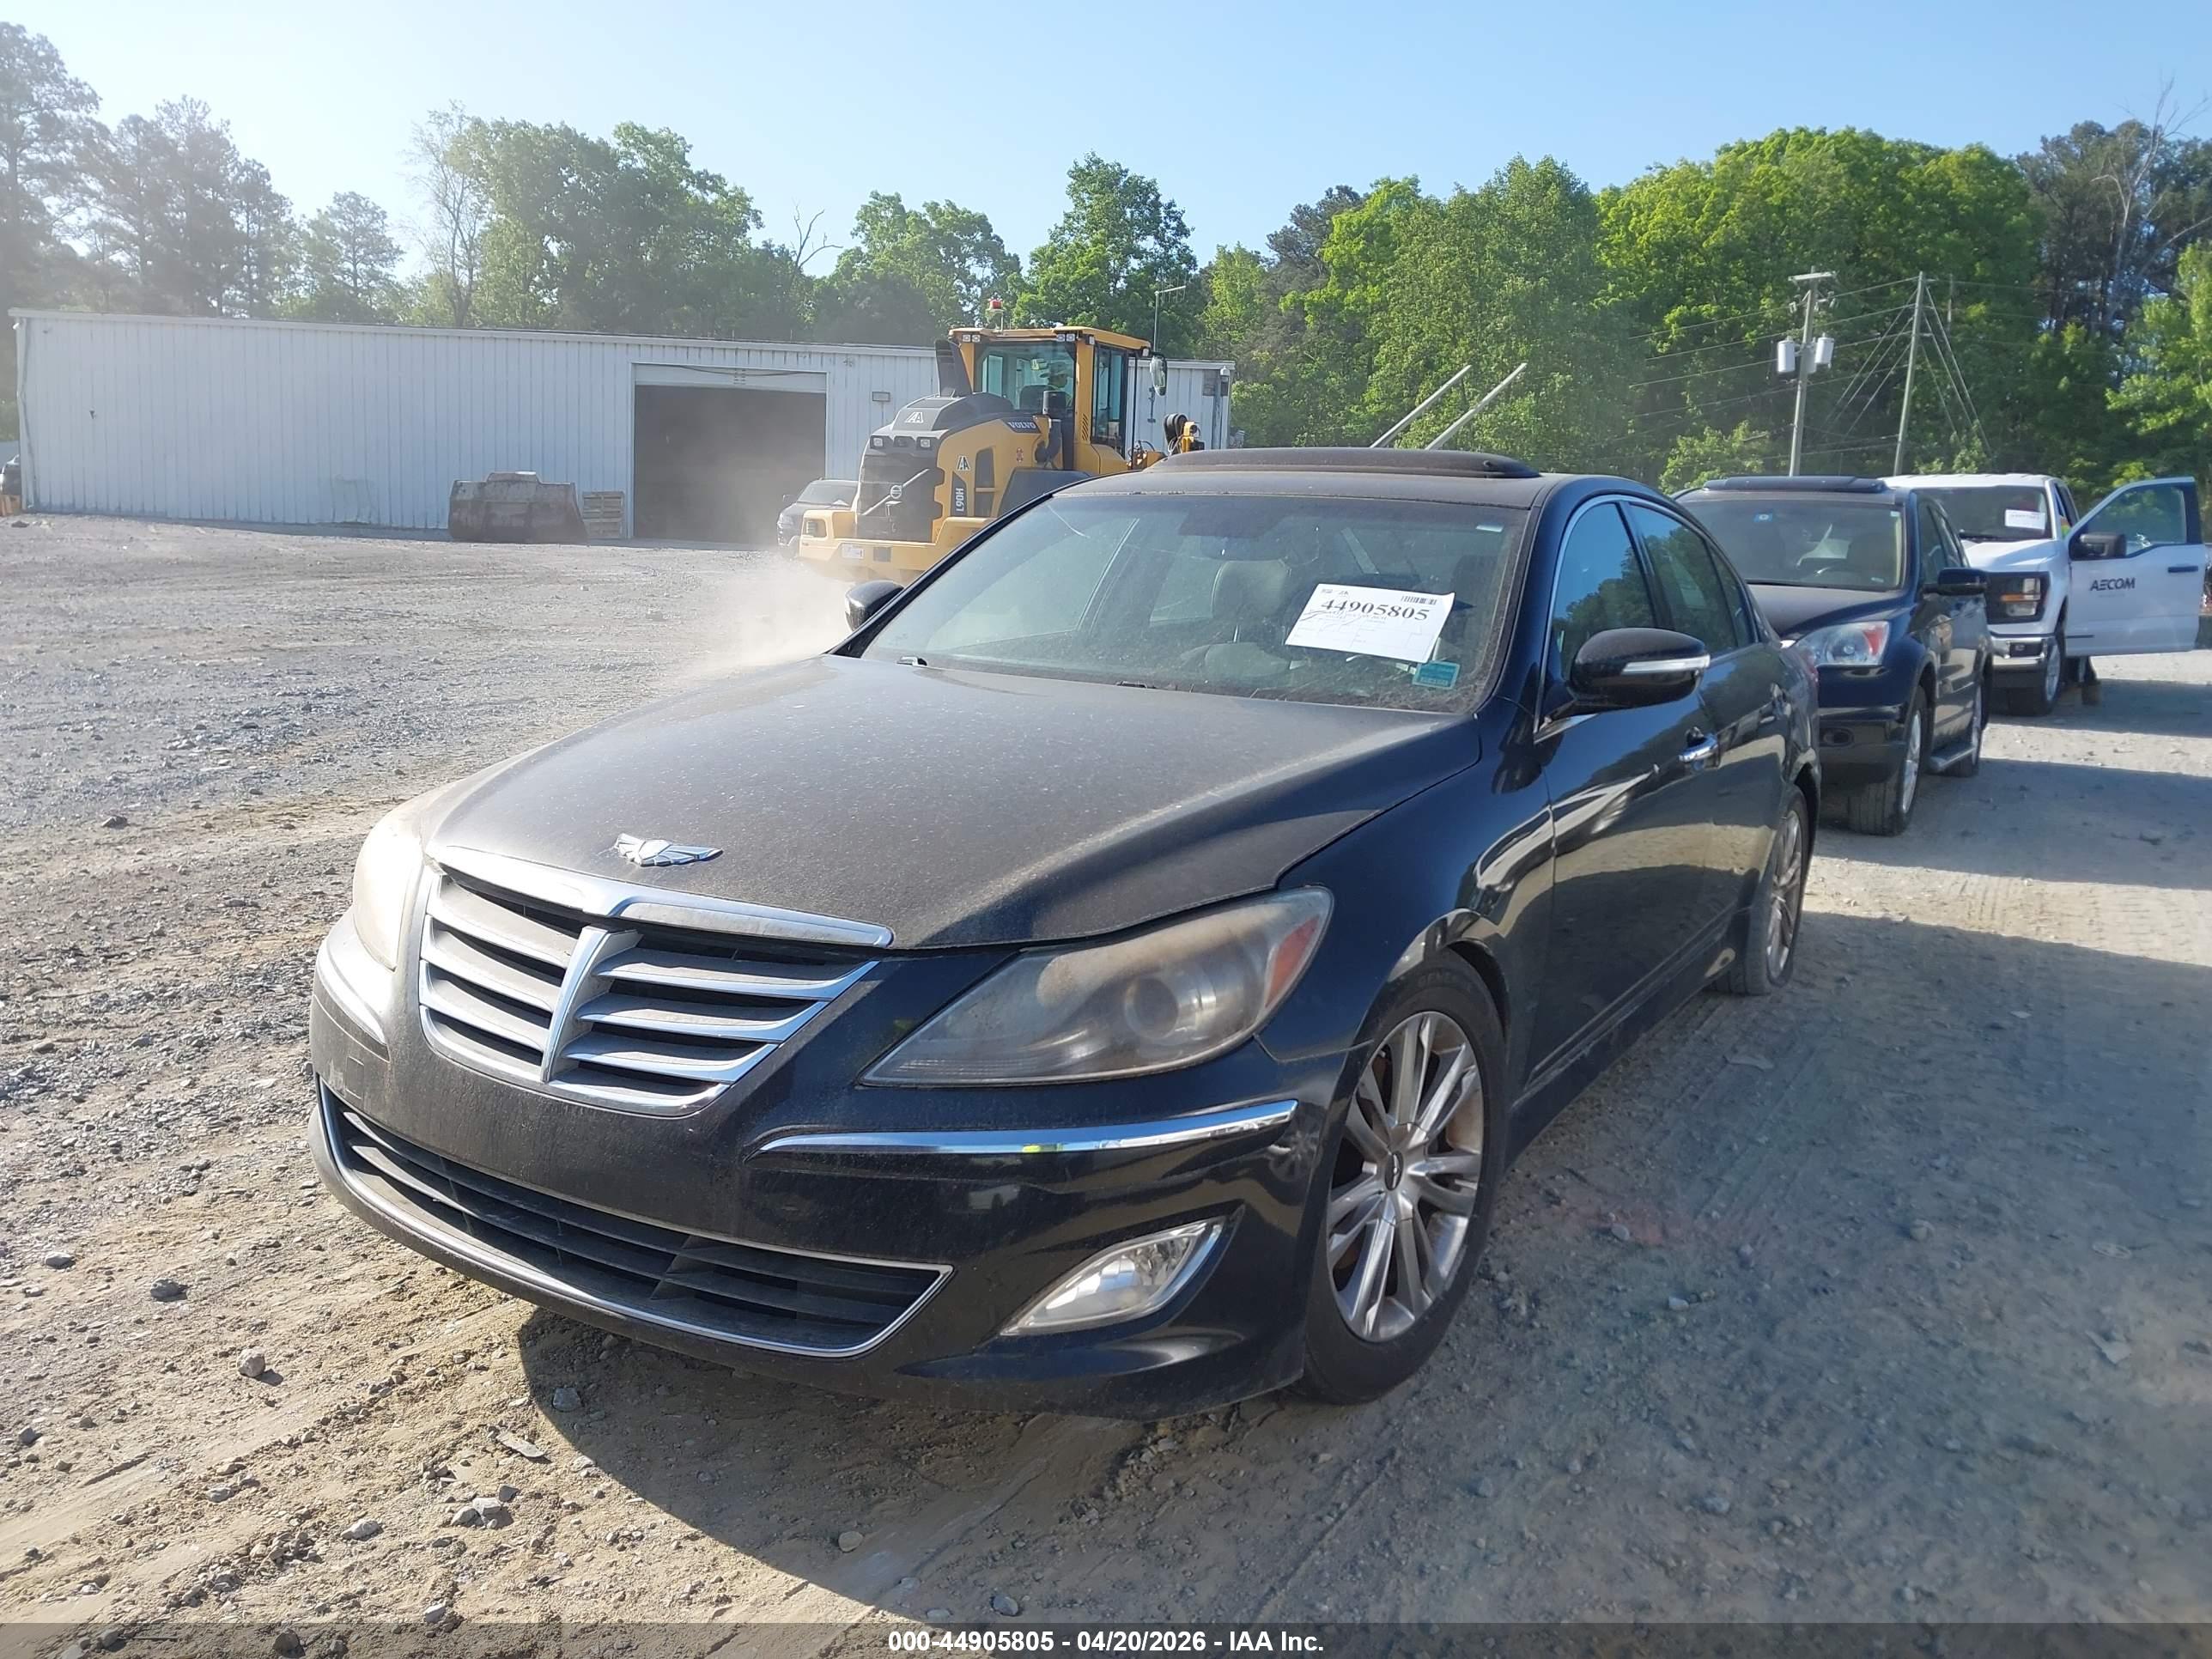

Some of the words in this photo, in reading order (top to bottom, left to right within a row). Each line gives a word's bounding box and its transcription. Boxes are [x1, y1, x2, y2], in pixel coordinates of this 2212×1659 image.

[955, 487, 964, 512] L90H
[2089, 577, 2136, 591] AECOM
[1321, 599, 1430, 621] 44905805
